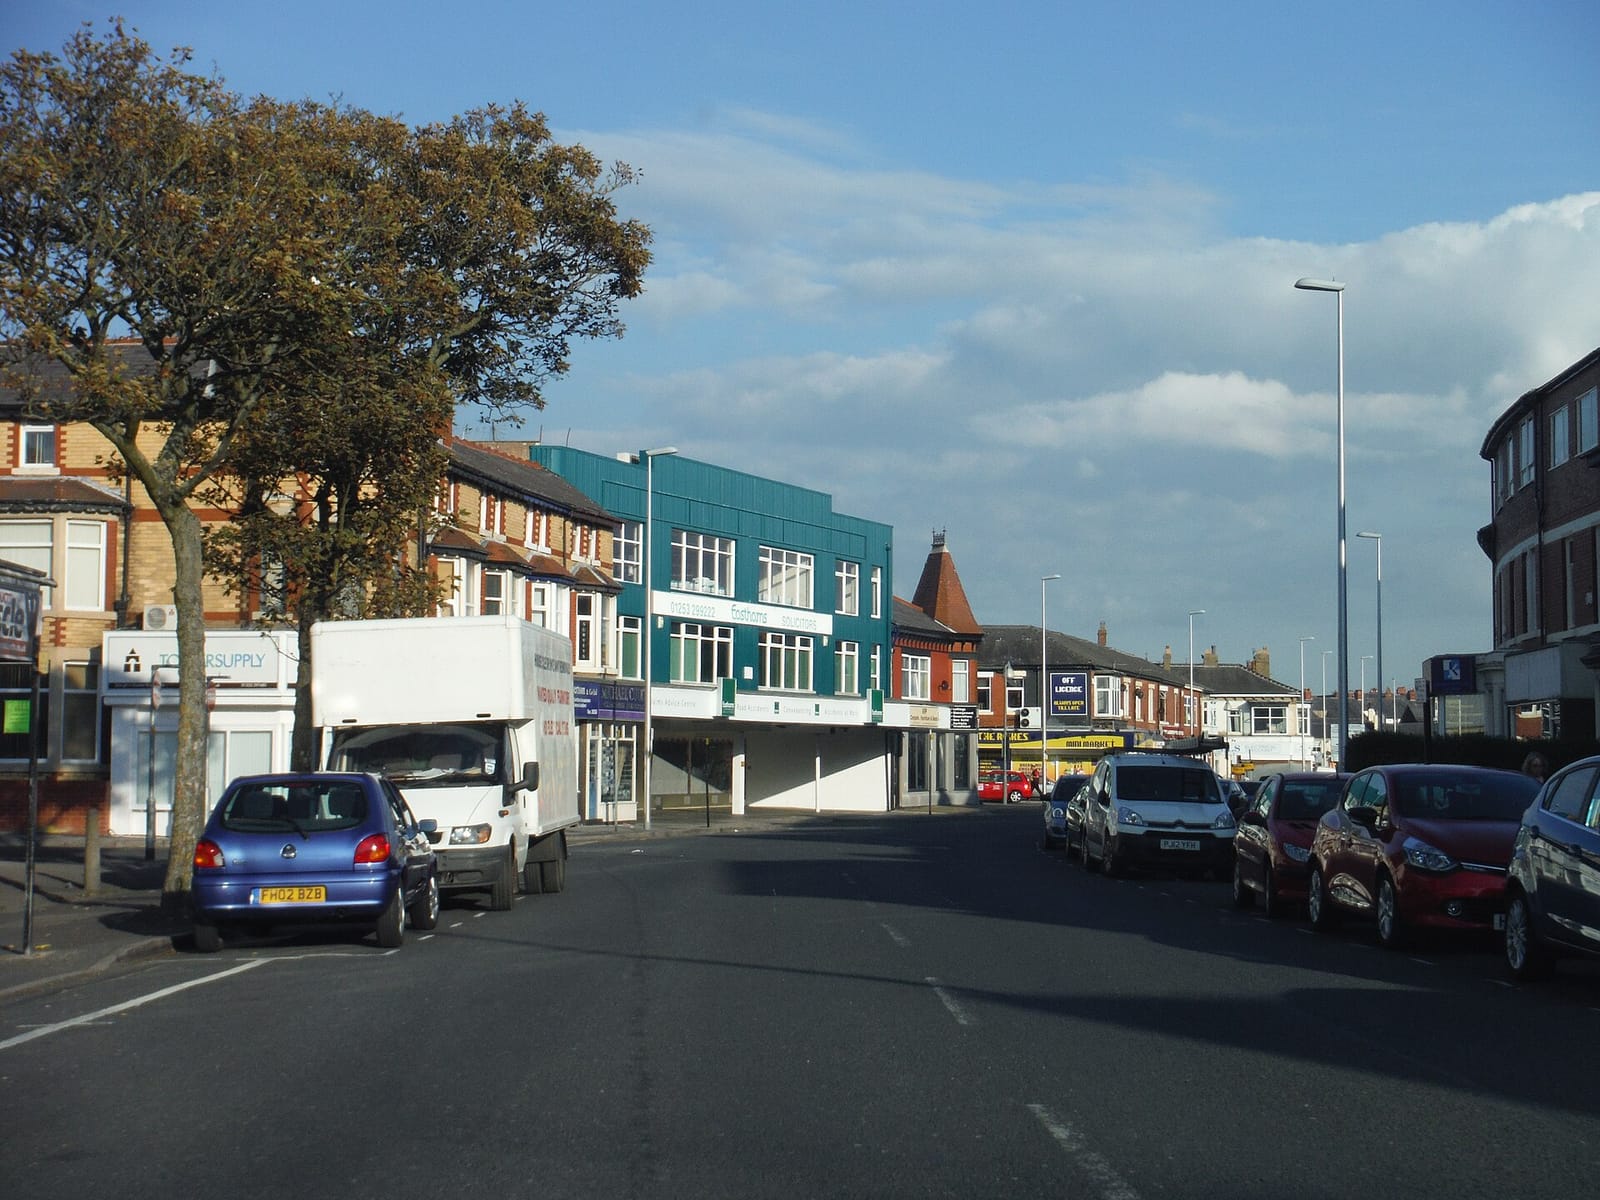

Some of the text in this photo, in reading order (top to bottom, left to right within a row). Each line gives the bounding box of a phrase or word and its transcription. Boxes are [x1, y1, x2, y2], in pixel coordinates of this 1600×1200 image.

[670, 601, 716, 618] 01253 299222
[781, 615, 817, 631] SOLICITORS
[160, 653, 265, 668] TORSUPPLY
[1066, 740, 1082, 748] MINI
[261, 888, 322, 901] FH02 BZB
